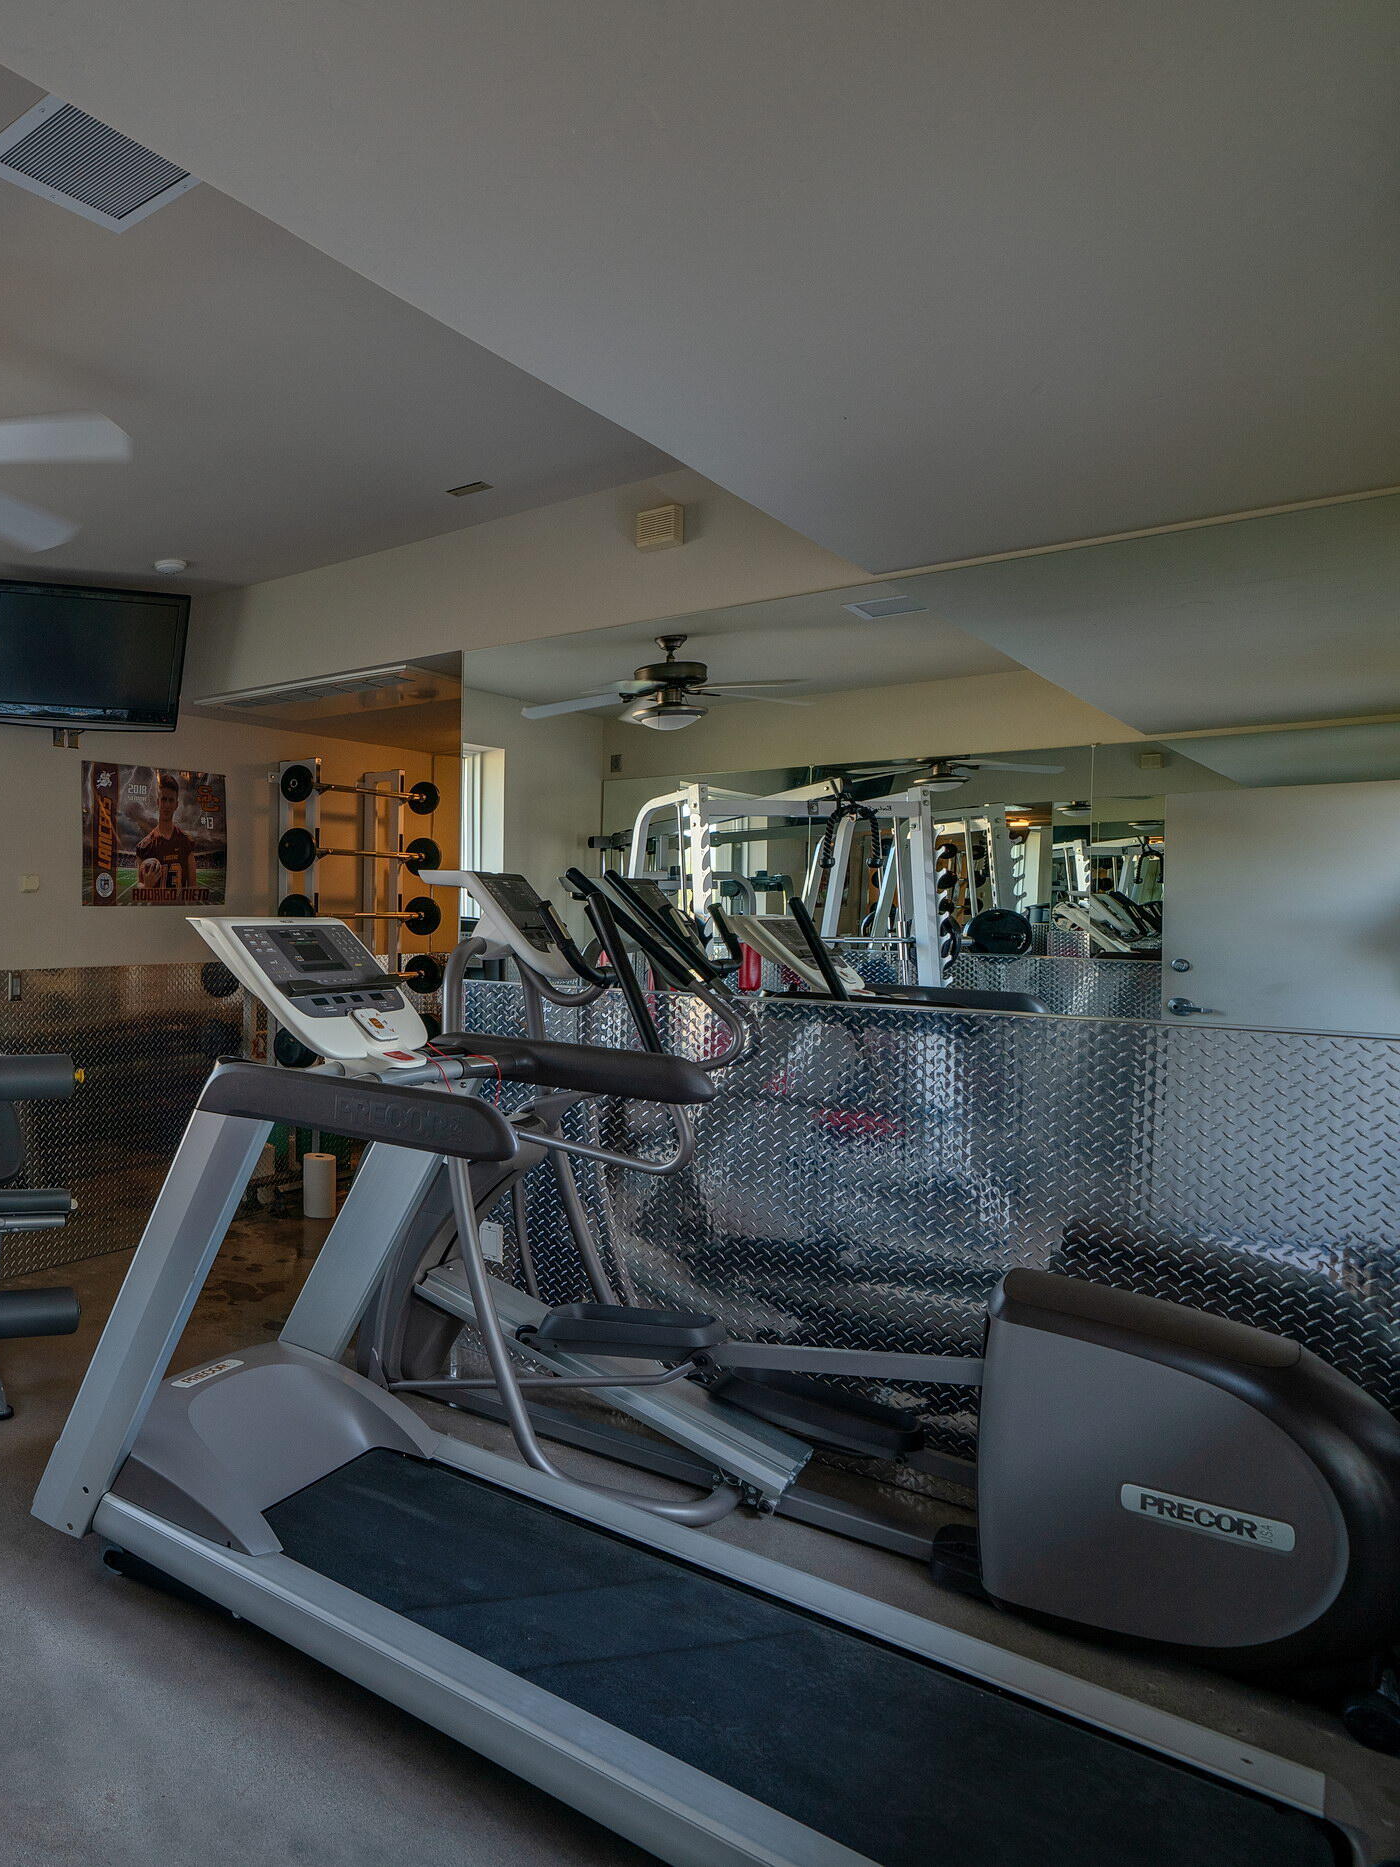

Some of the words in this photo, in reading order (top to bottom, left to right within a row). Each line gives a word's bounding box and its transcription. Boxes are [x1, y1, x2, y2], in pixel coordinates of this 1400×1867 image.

[127, 784, 148, 795] 2018
[132, 888, 177, 901] RODRIGO
[1140, 1493, 1257, 1540] PRECOR
